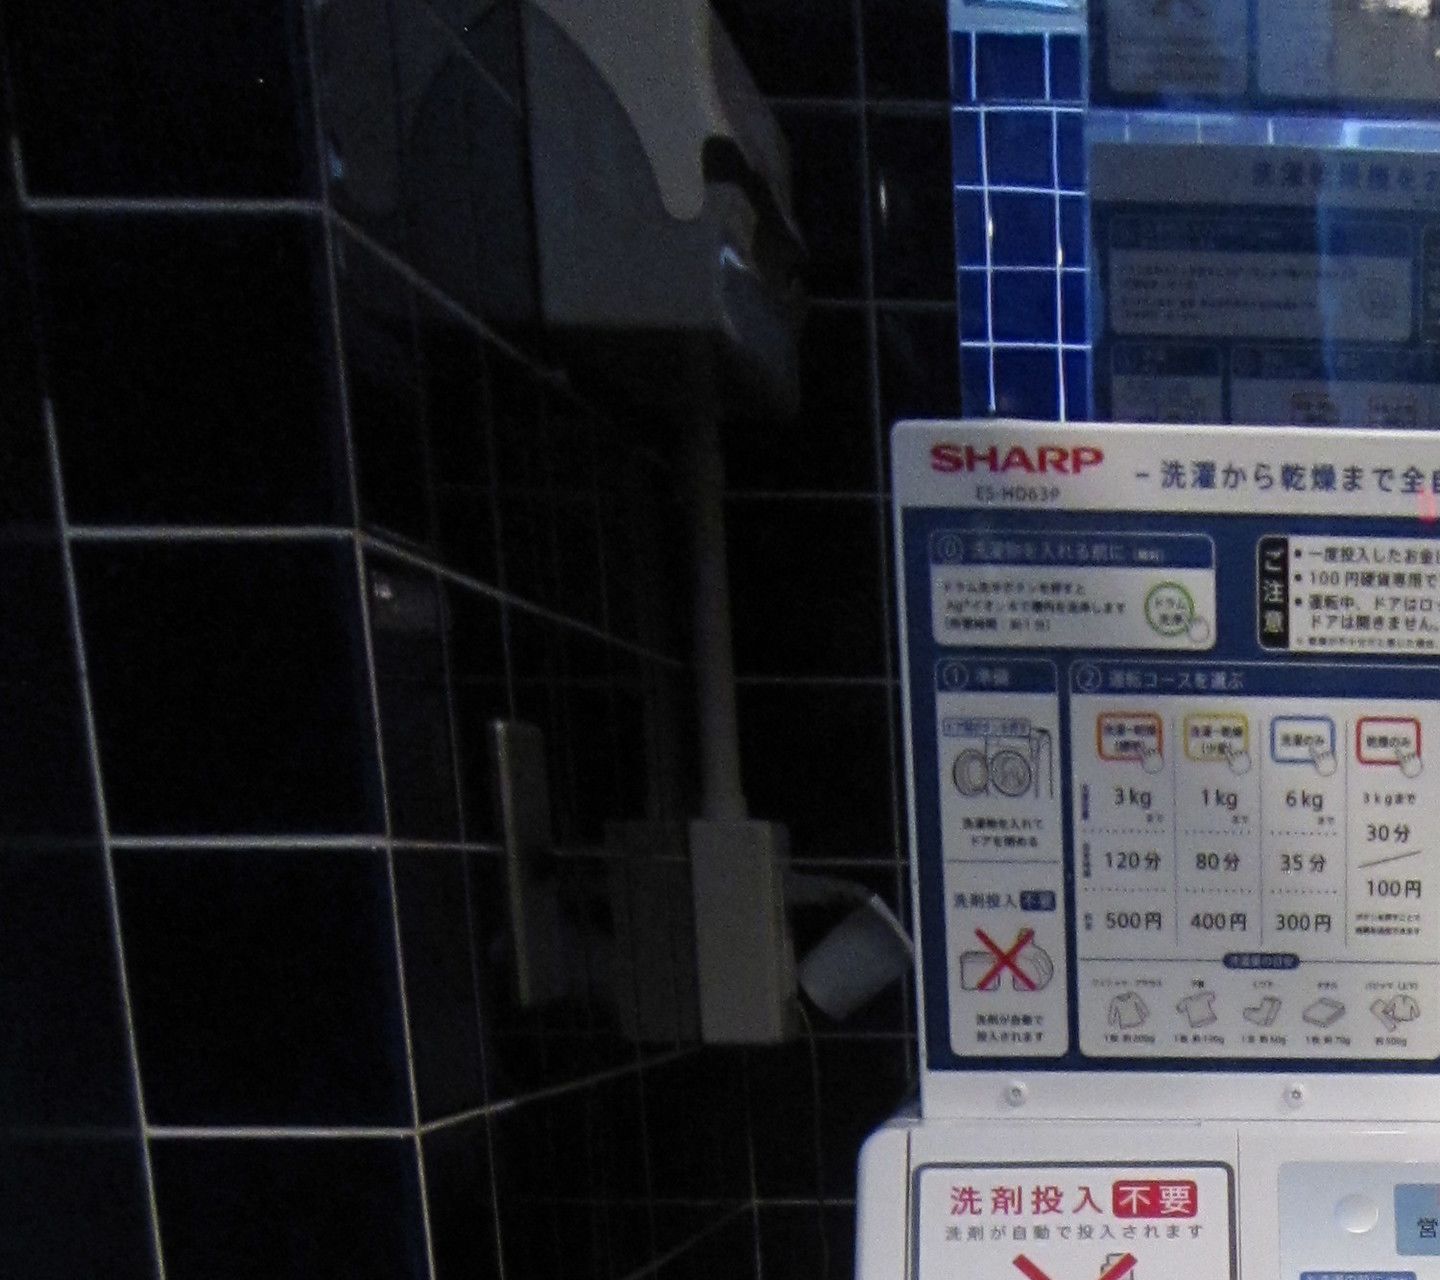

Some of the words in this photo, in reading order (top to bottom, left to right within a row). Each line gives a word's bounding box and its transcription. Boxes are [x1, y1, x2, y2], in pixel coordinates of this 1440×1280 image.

[932, 445, 1104, 473] SHARP
[1114, 786, 1152, 810] 3kg
[1202, 788, 1238, 811] 1kg
[1285, 790, 1324, 812] 6kg
[1367, 823, 1410, 843] 30分
[1105, 851, 1162, 873] 120分
[1195, 852, 1241, 873] 80分
[1280, 853, 1327, 873] 35分
[1367, 879, 1423, 899] 100円
[1106, 912, 1163, 931] 500円
[1190, 912, 1247, 932] 400円
[1275, 913, 1332, 932] 300円
[950, 1186, 1103, 1216] 洗剤投入
[1118, 1186, 1192, 1214] 不要
[945, 1223, 1204, 1242] 洗剤が自動で投入されます
